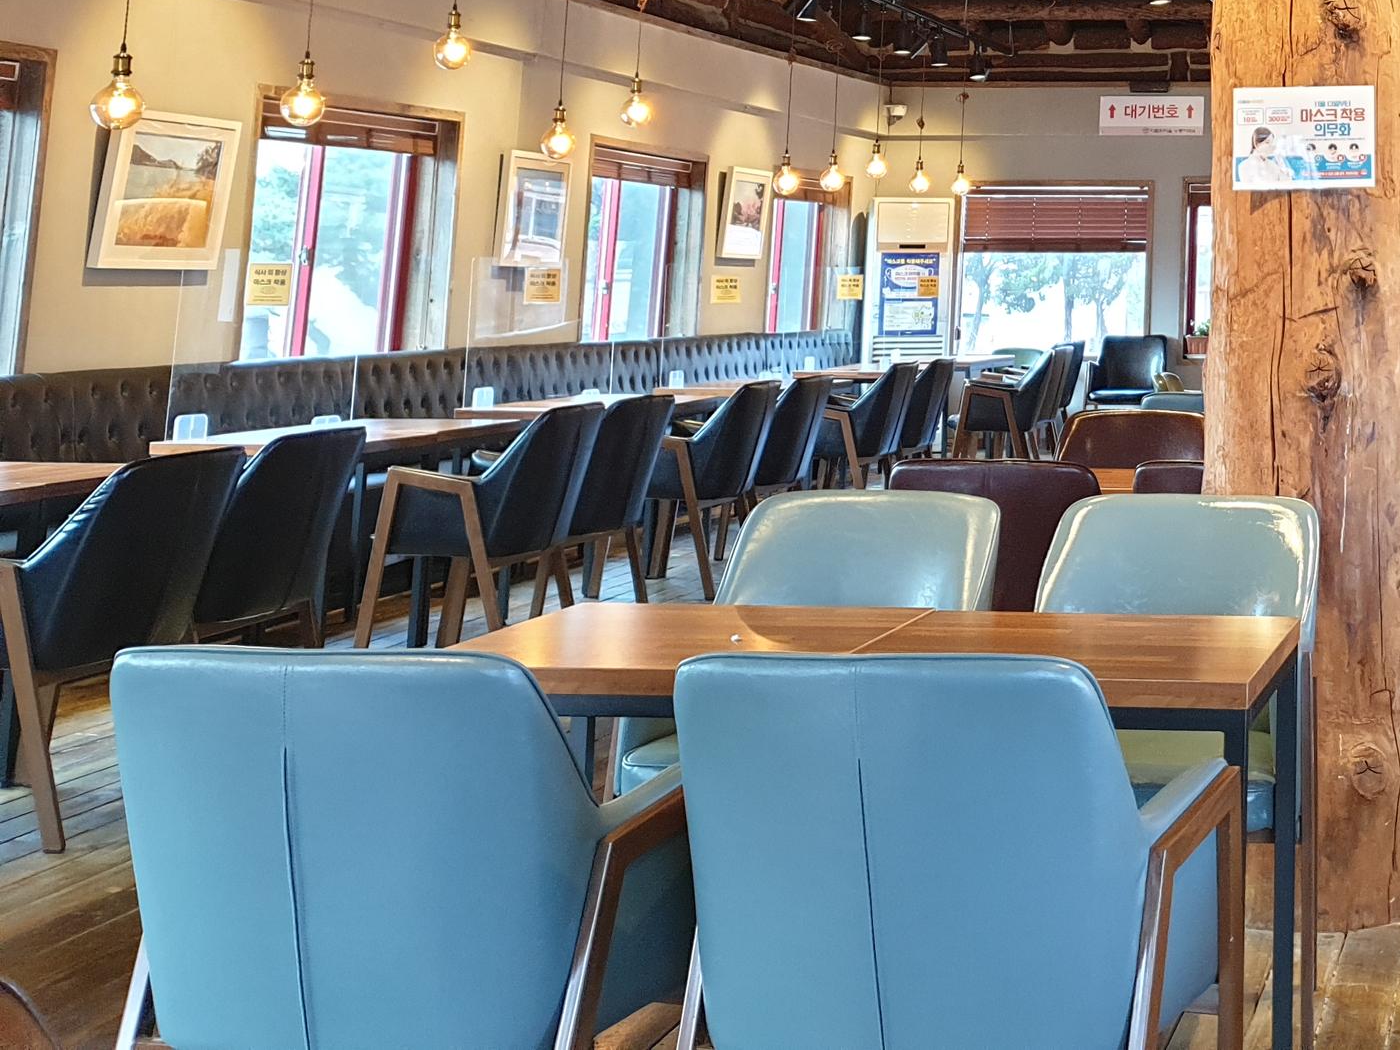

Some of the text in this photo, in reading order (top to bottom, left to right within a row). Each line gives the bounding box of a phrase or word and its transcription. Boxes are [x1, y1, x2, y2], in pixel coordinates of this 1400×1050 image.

[1124, 103, 1179, 120] 대기번호
[1300, 107, 1366, 123] 마스크 착용
[1314, 122, 1352, 137] 의무화
